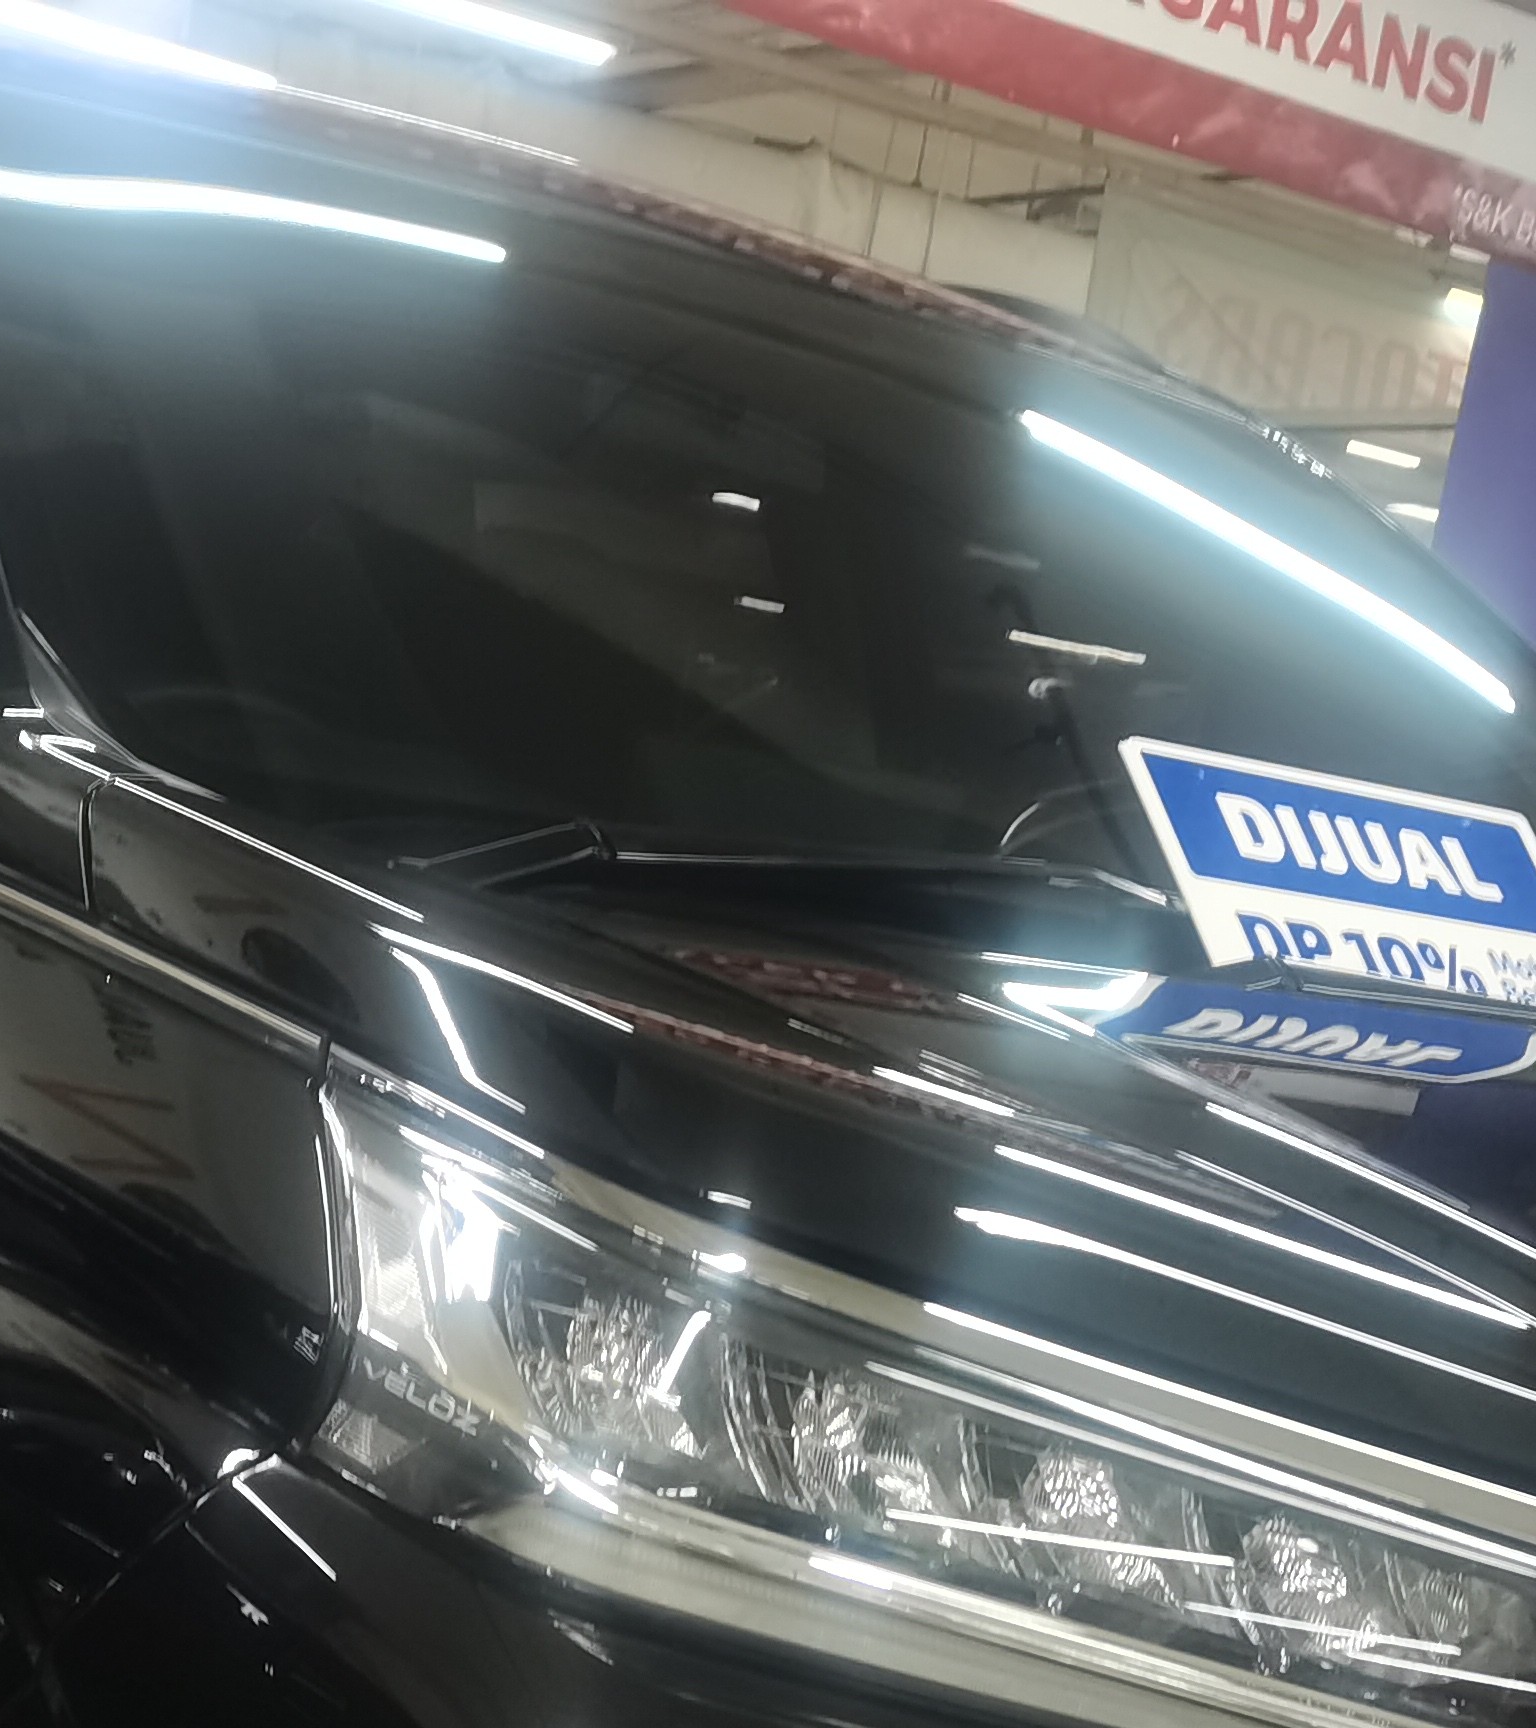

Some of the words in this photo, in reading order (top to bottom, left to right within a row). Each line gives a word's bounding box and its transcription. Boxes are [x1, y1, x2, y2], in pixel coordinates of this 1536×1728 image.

[1161, 0, 1517, 124] ARANSI
[1215, 791, 1504, 902] DIJUAL
[1340, 928, 1489, 998] 10%
